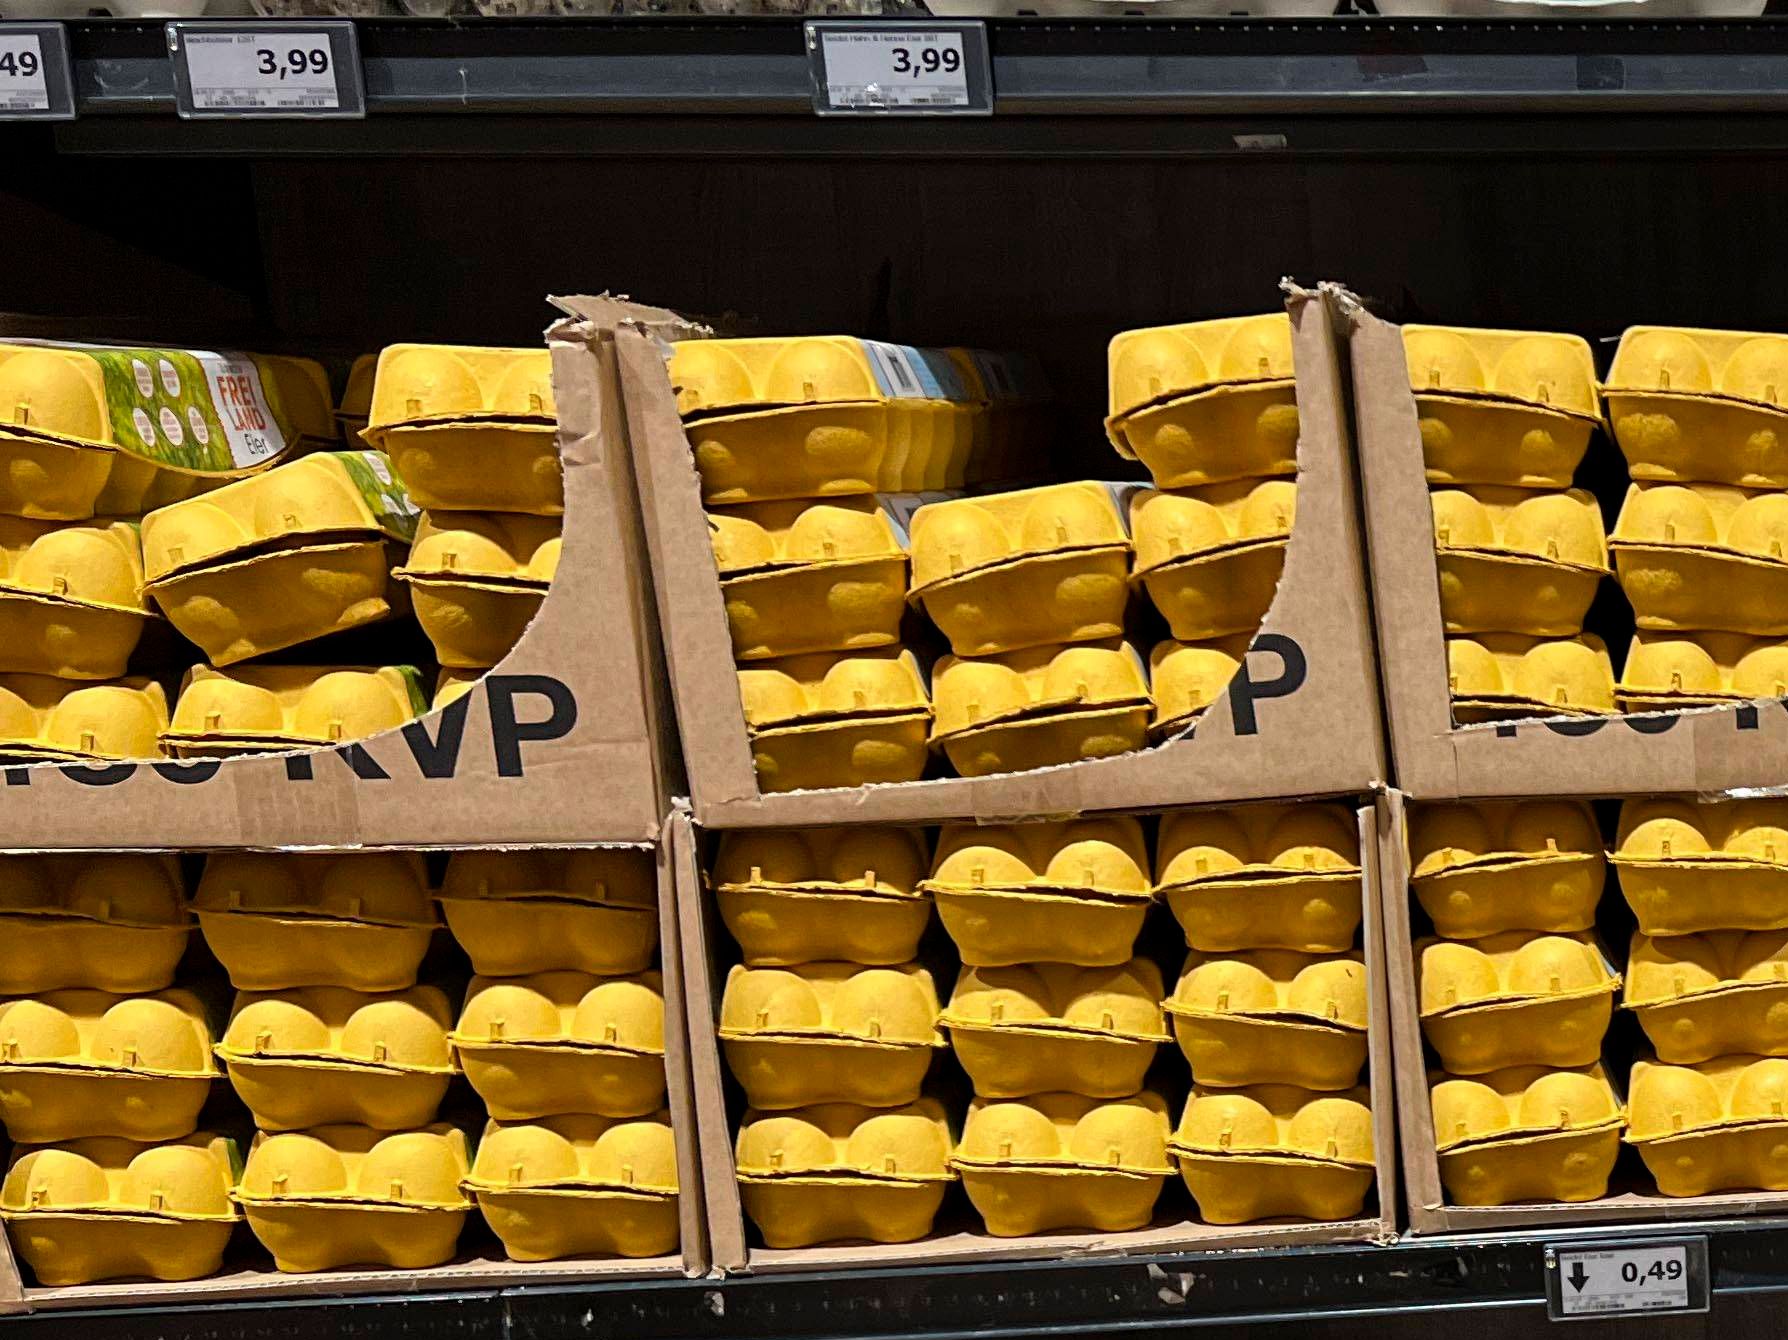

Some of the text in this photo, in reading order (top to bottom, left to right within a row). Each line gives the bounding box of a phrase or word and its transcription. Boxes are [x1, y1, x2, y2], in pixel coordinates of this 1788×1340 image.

[256, 48, 329, 80] 3,99
[892, 47, 960, 78] 3,99
[216, 375, 257, 407] FREI
[226, 405, 266, 432] LAND
[244, 433, 269, 455] Eier
[1621, 1259, 1682, 1287] 0,49
